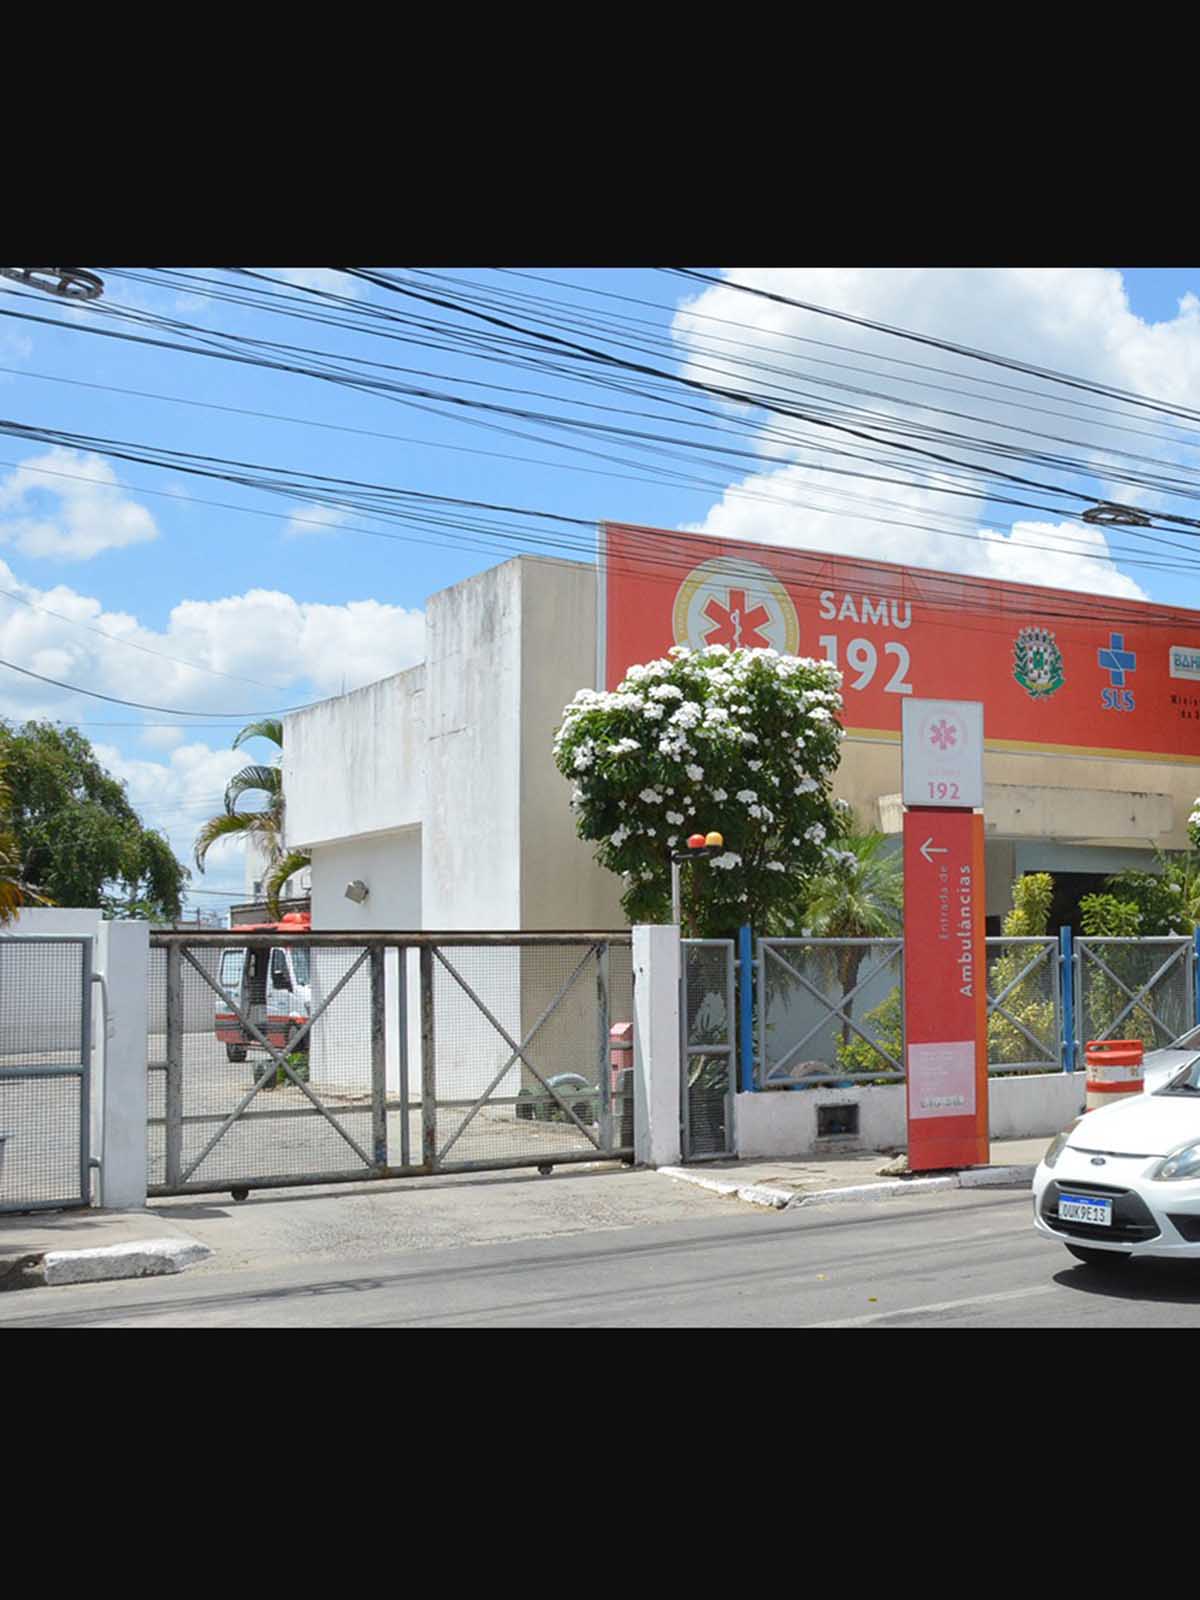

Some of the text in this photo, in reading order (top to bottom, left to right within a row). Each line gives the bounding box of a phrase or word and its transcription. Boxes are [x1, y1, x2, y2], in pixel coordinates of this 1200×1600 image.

[819, 591, 912, 629] SAMU
[819, 635, 913, 694] 192
[928, 782, 960, 800] 192
[957, 864, 973, 997] Ambulâncias
